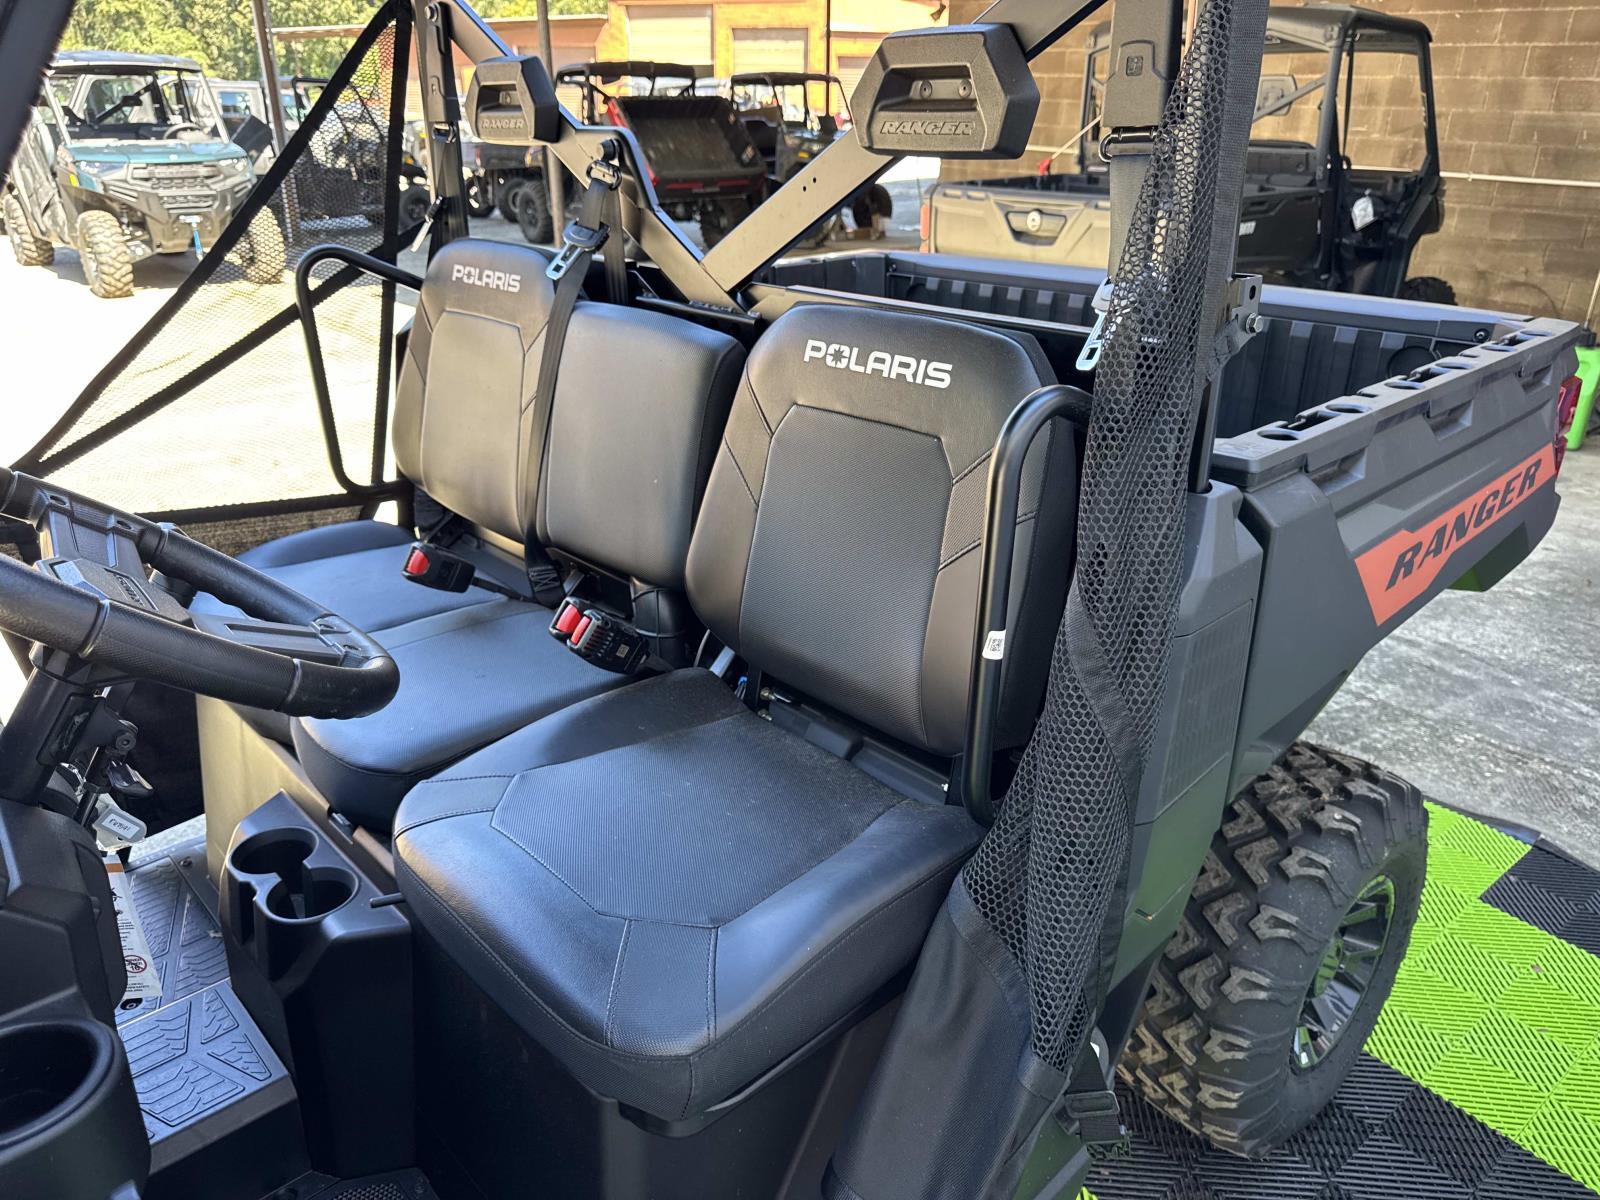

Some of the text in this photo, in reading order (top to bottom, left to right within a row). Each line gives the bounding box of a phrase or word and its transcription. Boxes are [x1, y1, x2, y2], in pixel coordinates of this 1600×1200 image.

[481, 119, 524, 129] RANGER
[880, 120, 976, 135] RANGER
[452, 264, 521, 293] POLARIS
[803, 339, 953, 389] POLARIS
[1385, 458, 1543, 592] RANGER
